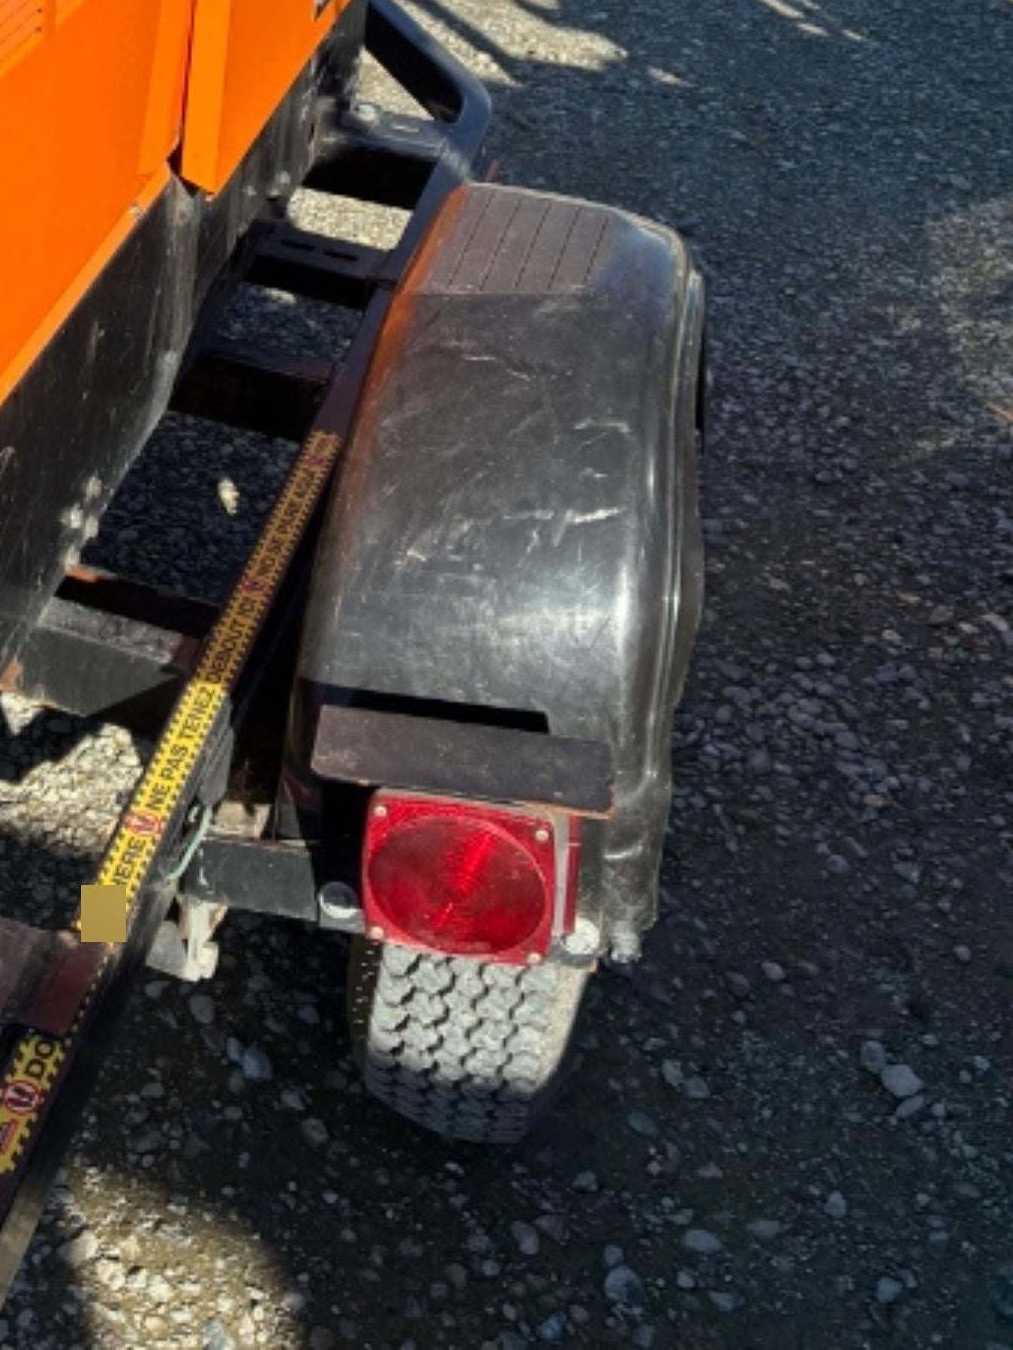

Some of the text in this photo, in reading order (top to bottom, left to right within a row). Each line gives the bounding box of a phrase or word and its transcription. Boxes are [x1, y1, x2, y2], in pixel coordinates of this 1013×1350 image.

[145, 782, 170, 812] NE
[160, 745, 190, 784] PAS
[24, 1040, 56, 1078] DO
